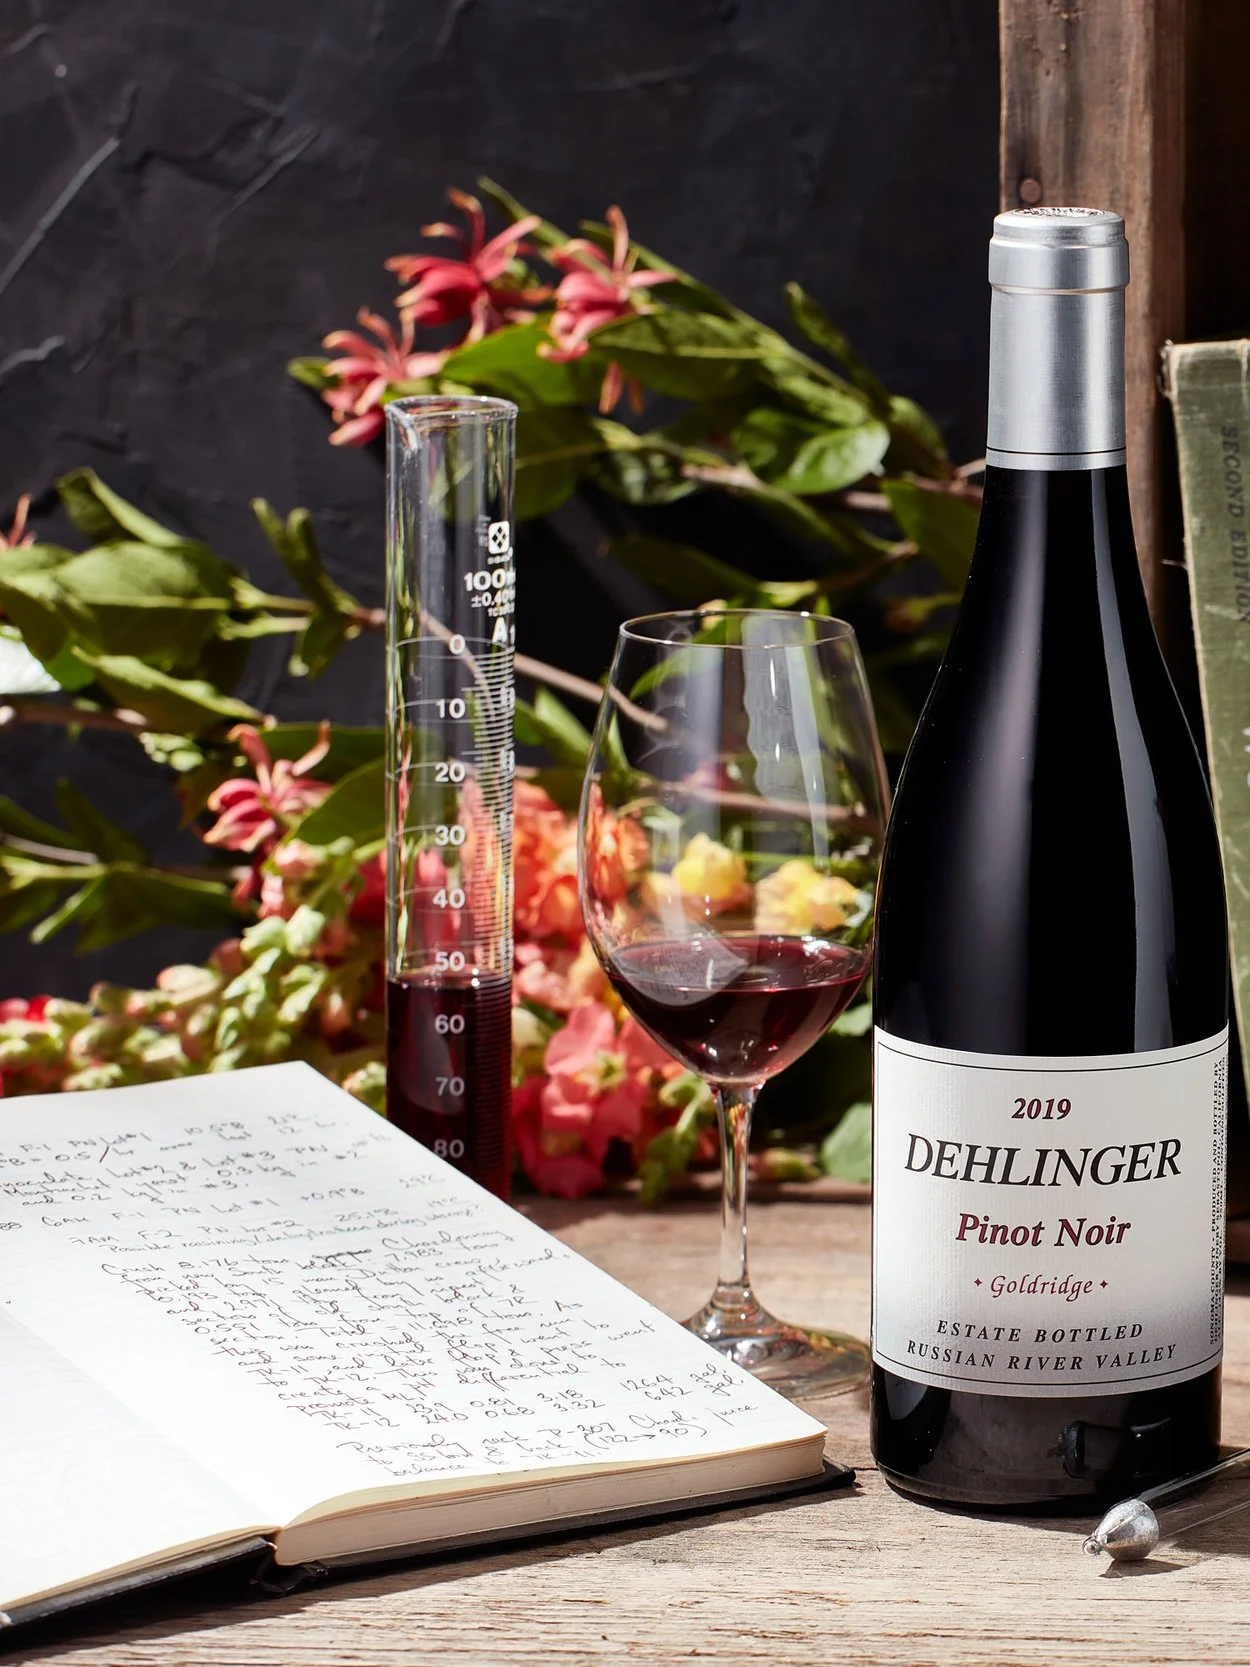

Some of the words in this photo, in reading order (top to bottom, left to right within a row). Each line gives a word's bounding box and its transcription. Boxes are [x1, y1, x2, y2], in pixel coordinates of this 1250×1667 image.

[1220, 425, 1246, 519] SECOND
[448, 634, 467, 655] 0
[436, 698, 466, 719] 10
[434, 762, 466, 783] 20
[434, 825, 467, 846] 30
[432, 887, 466, 909] 40
[434, 951, 466, 972] 50
[434, 1014, 466, 1034] 60
[435, 1076, 465, 1097] 70
[1011, 1098, 1072, 1120] 2019
[434, 1139, 465, 1159] 80
[904, 1133, 1182, 1187] DEHLINGER
[955, 1212, 1045, 1247] Pinot
[1054, 1217, 1132, 1247] Noir
[101, 1263, 167, 1276] Crush
[990, 1274, 1093, 1302] Goldridge
[937, 1319, 1022, 1343] ESTATE
[1034, 1323, 1143, 1343] BOTTLED
[907, 1339, 996, 1369] RUSSIAN
[1007, 1355, 1084, 1371] RIVER
[1096, 1343, 1178, 1369] VALLEY
